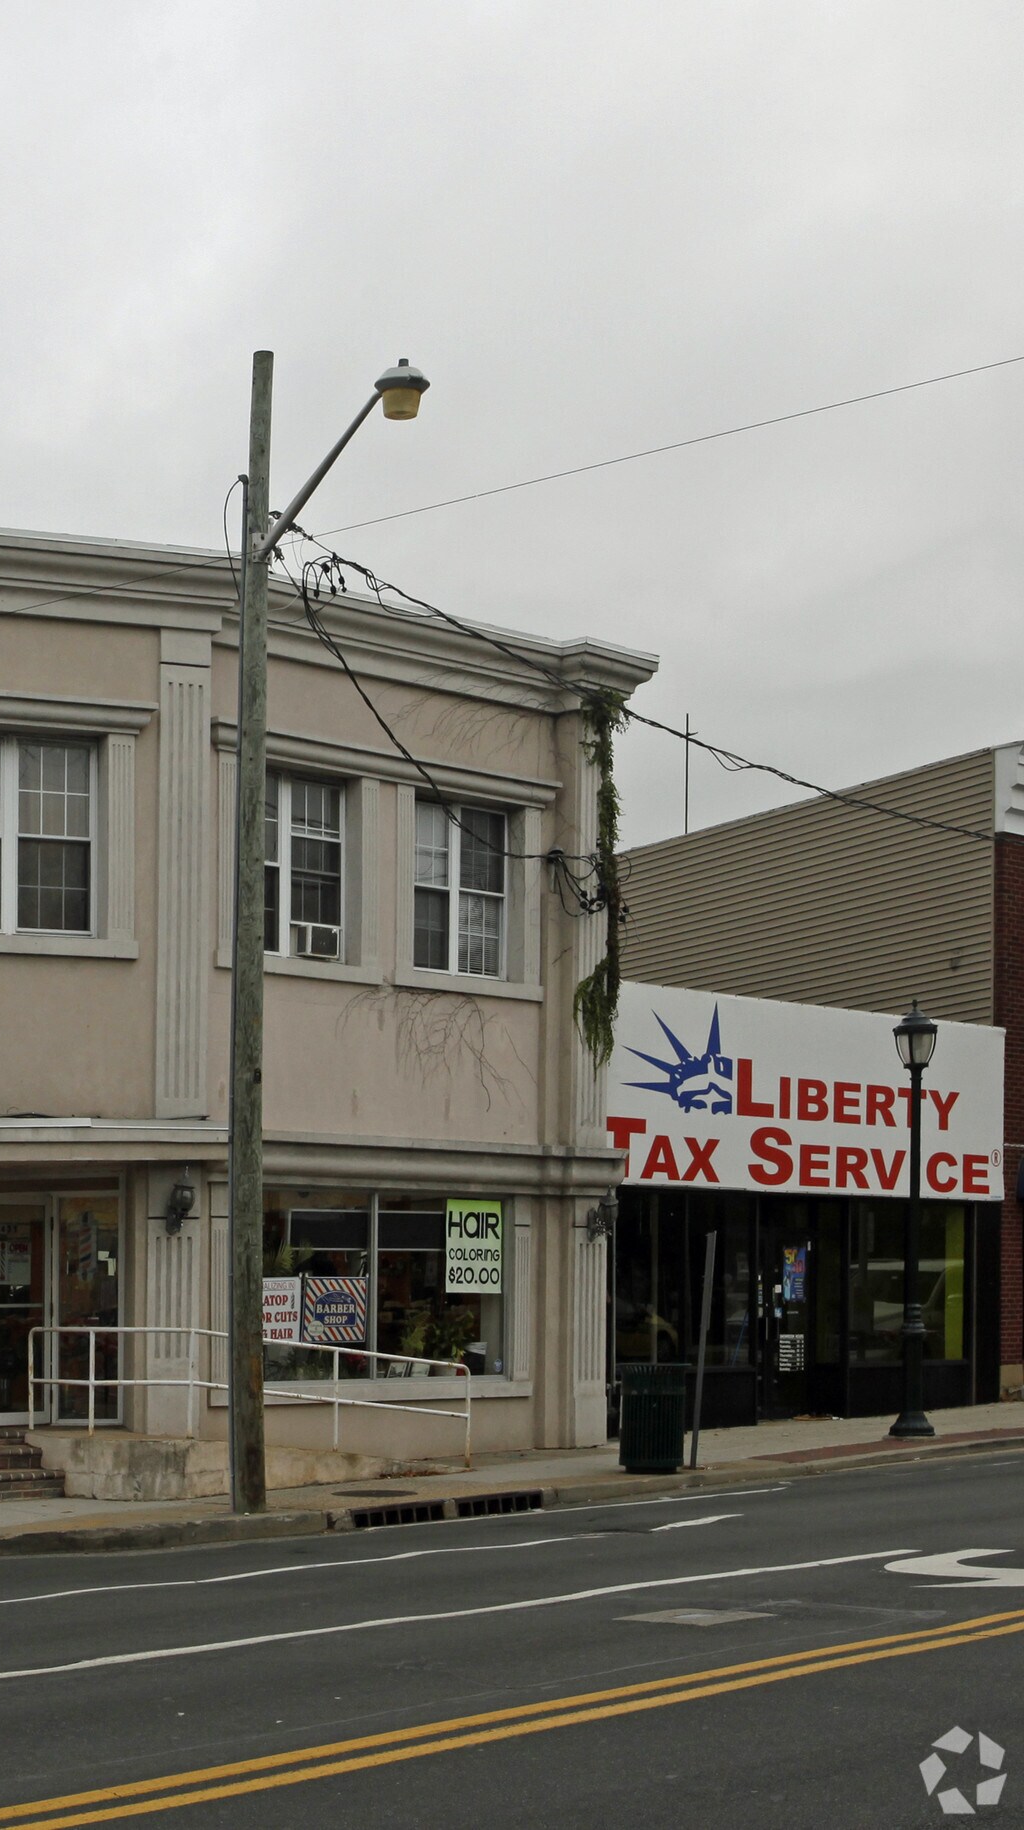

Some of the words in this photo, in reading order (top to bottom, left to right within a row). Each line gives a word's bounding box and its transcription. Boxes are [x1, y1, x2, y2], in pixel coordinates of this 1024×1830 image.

[736, 1058, 960, 1131] LIBERTY
[607, 1116, 720, 1183] TAX
[748, 1126, 990, 1194] SERVCE
[448, 1266, 500, 1284] $20.00
[262, 1295, 288, 1306] ATOP
[316, 1304, 355, 1313] BARBER
[274, 1311, 298, 1322] CUTS
[324, 1315, 348, 1324] SHOP
[271, 1329, 293, 1339] HAIR
